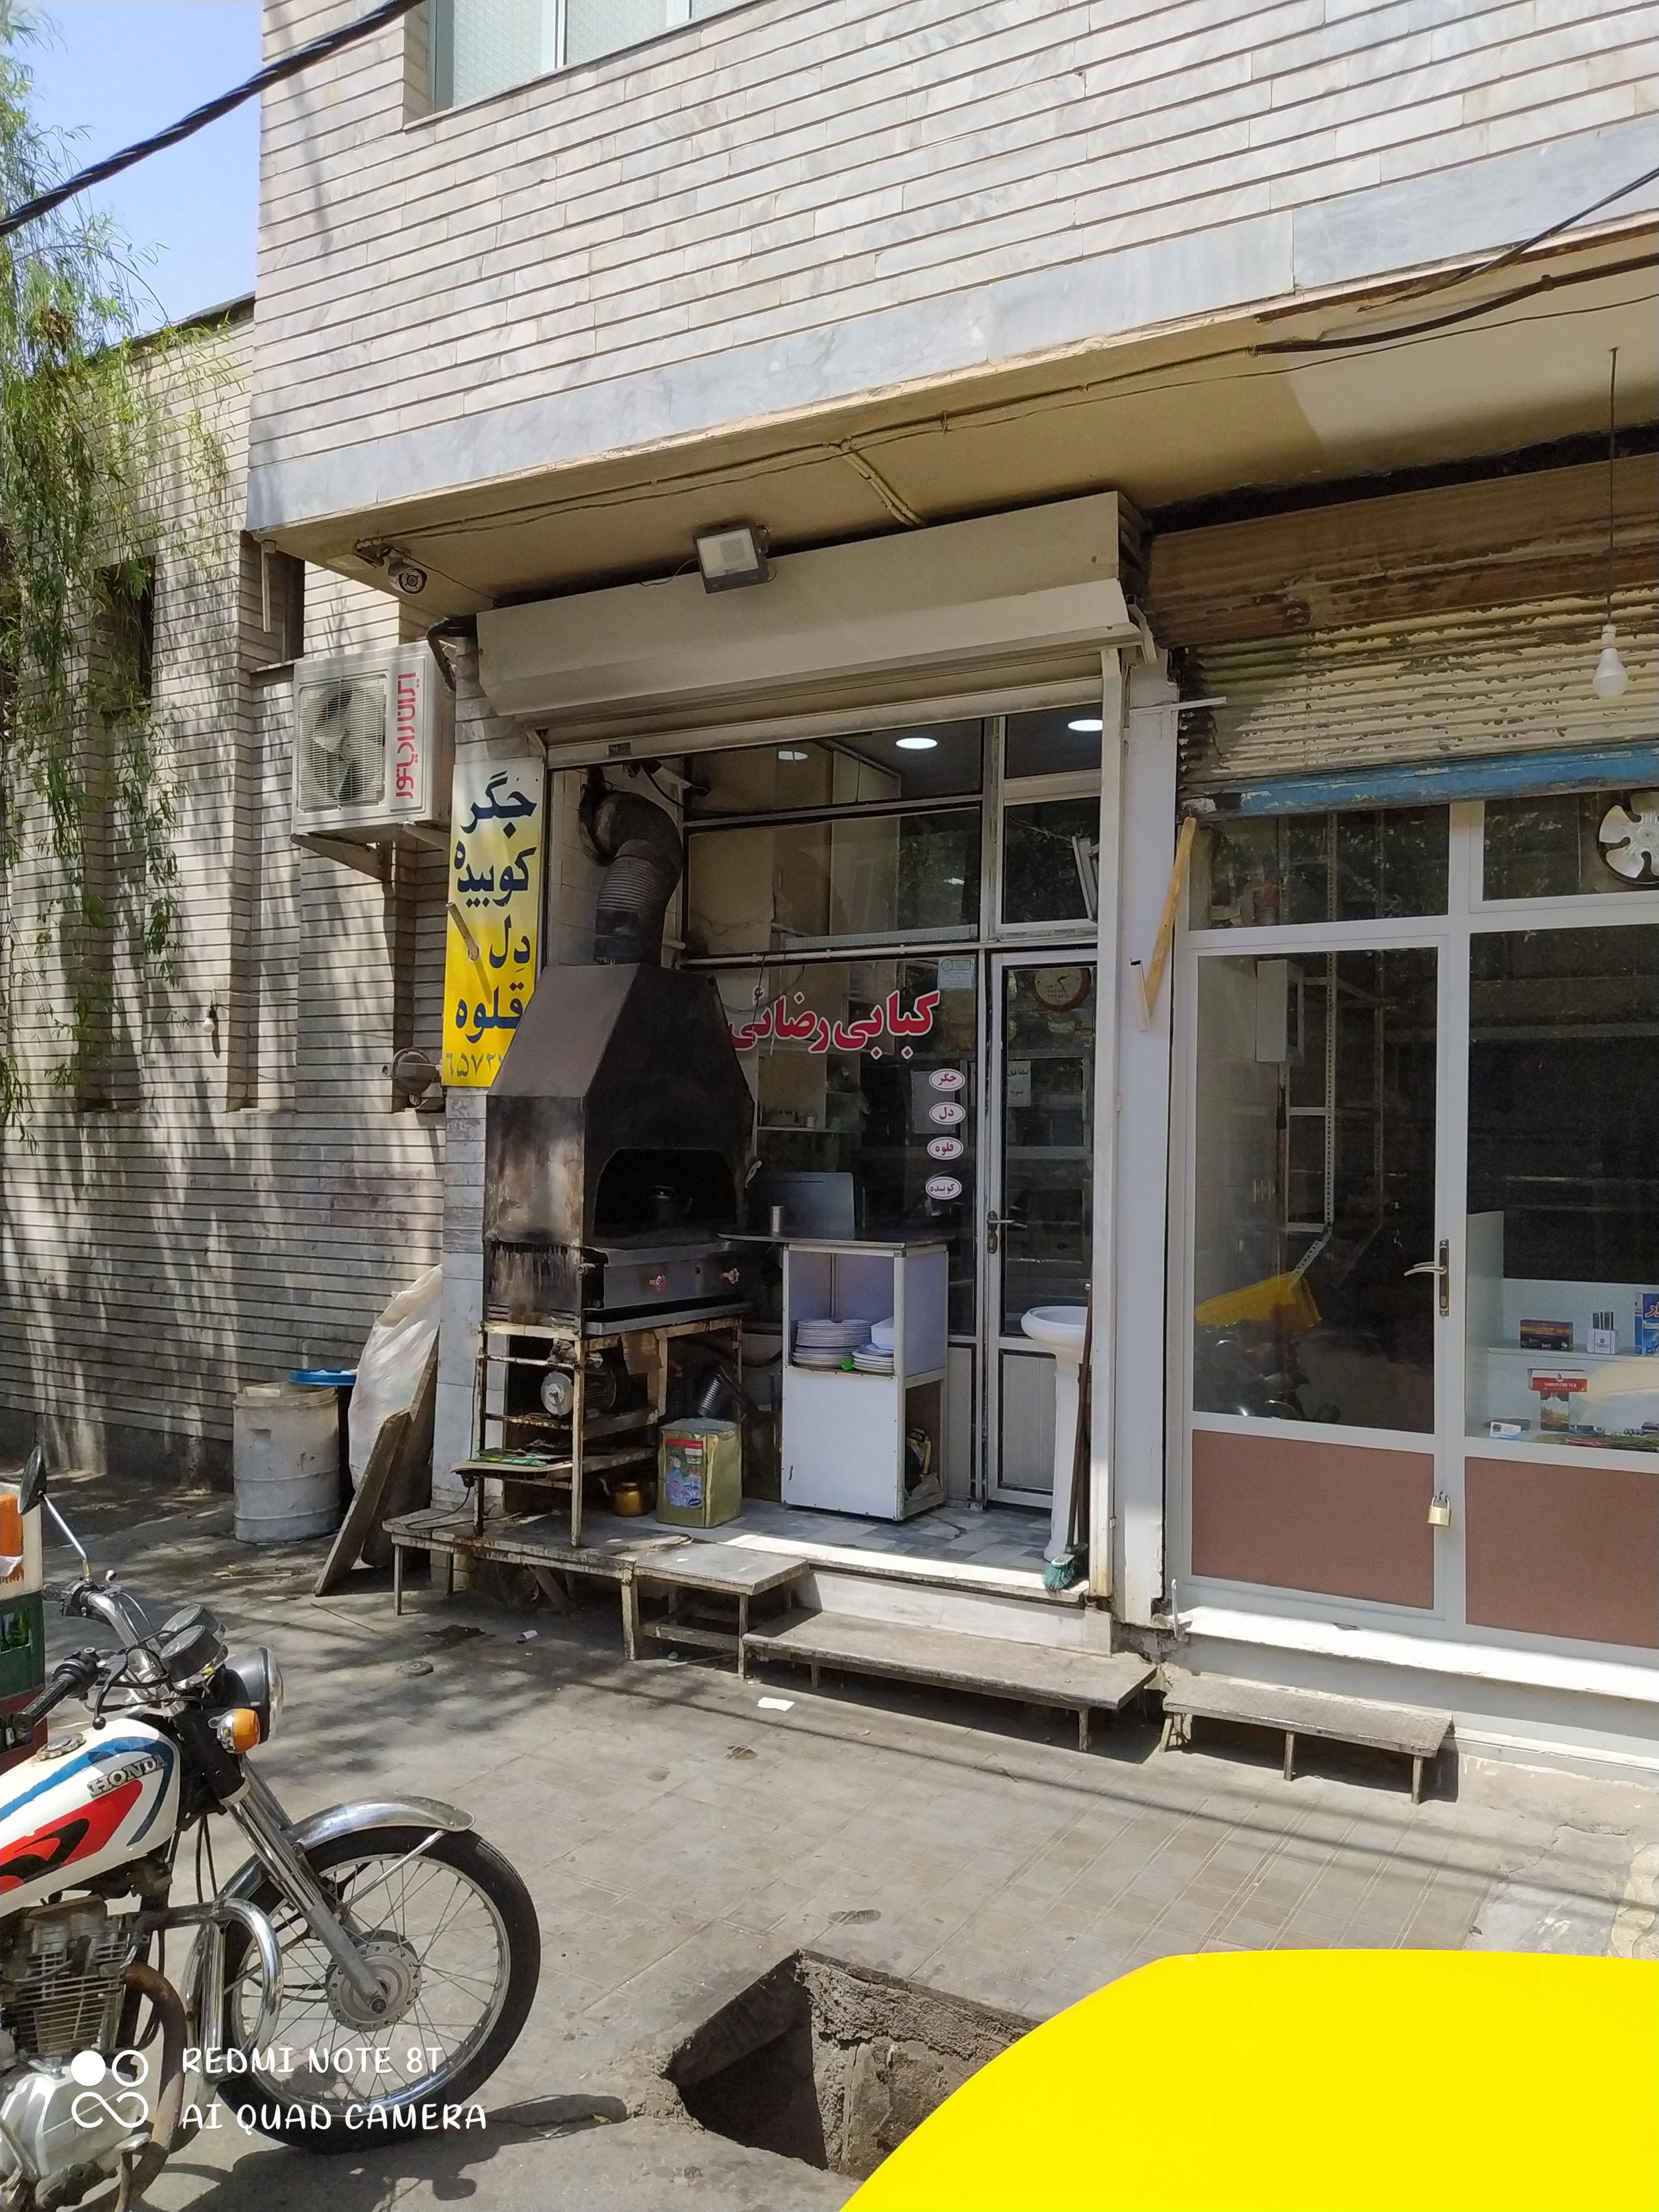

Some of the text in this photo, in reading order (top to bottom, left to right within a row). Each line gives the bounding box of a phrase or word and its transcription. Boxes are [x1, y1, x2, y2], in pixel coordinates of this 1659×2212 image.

[397, 672, 420, 722] ایران
[460, 770, 538, 839] جگر
[453, 840, 538, 908] کوبیده
[455, 981, 525, 1044] قلوه
[832, 989, 940, 1060] کبابی
[937, 1072, 957, 1086] جگر
[939, 1107, 954, 1120] دل
[935, 1141, 954, 1156] قلوه
[86, 1754, 168, 1796] HONDA
